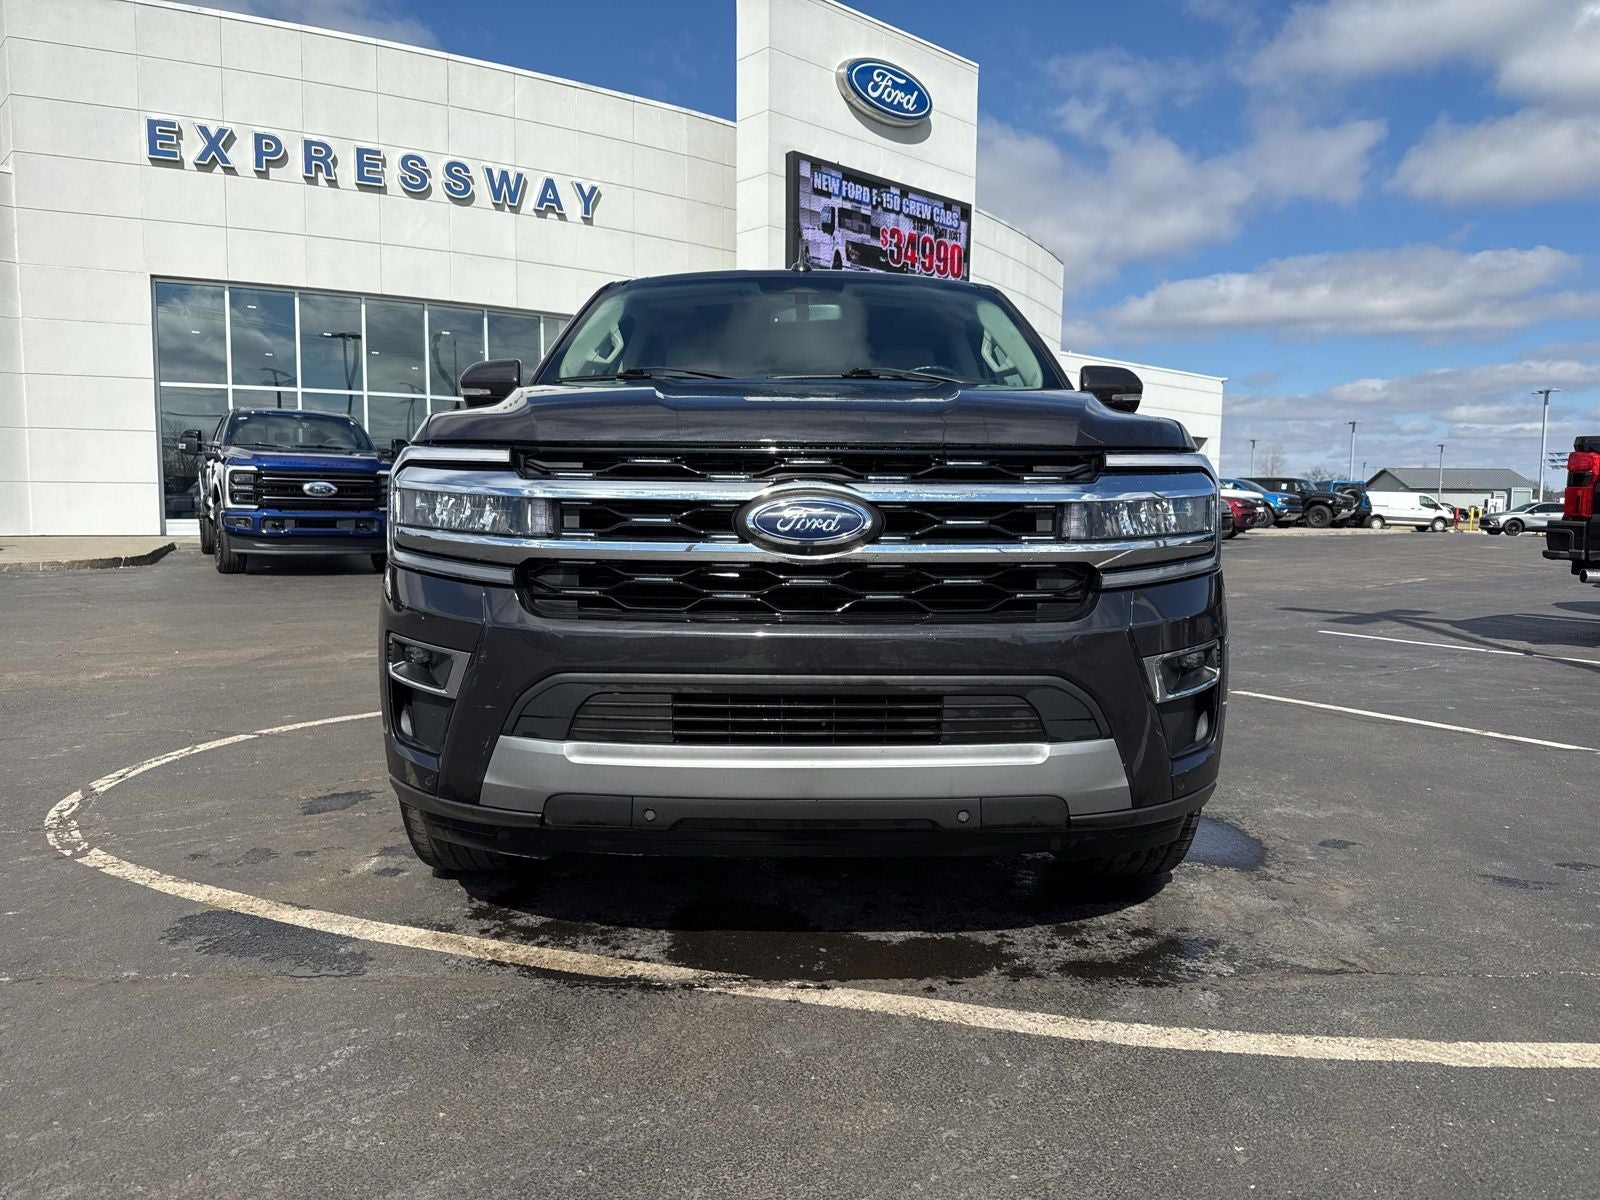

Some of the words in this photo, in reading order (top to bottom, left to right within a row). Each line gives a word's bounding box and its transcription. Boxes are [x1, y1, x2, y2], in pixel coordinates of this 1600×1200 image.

[868, 68, 918, 111] Ford
[145, 116, 602, 219] EXPRESSWAY
[813, 171, 841, 196] NEW
[842, 180, 871, 204] FORD
[872, 188, 901, 212] F-150
[902, 198, 932, 220] CREW
[933, 206, 960, 228] CABS
[776, 506, 841, 532] Ford
